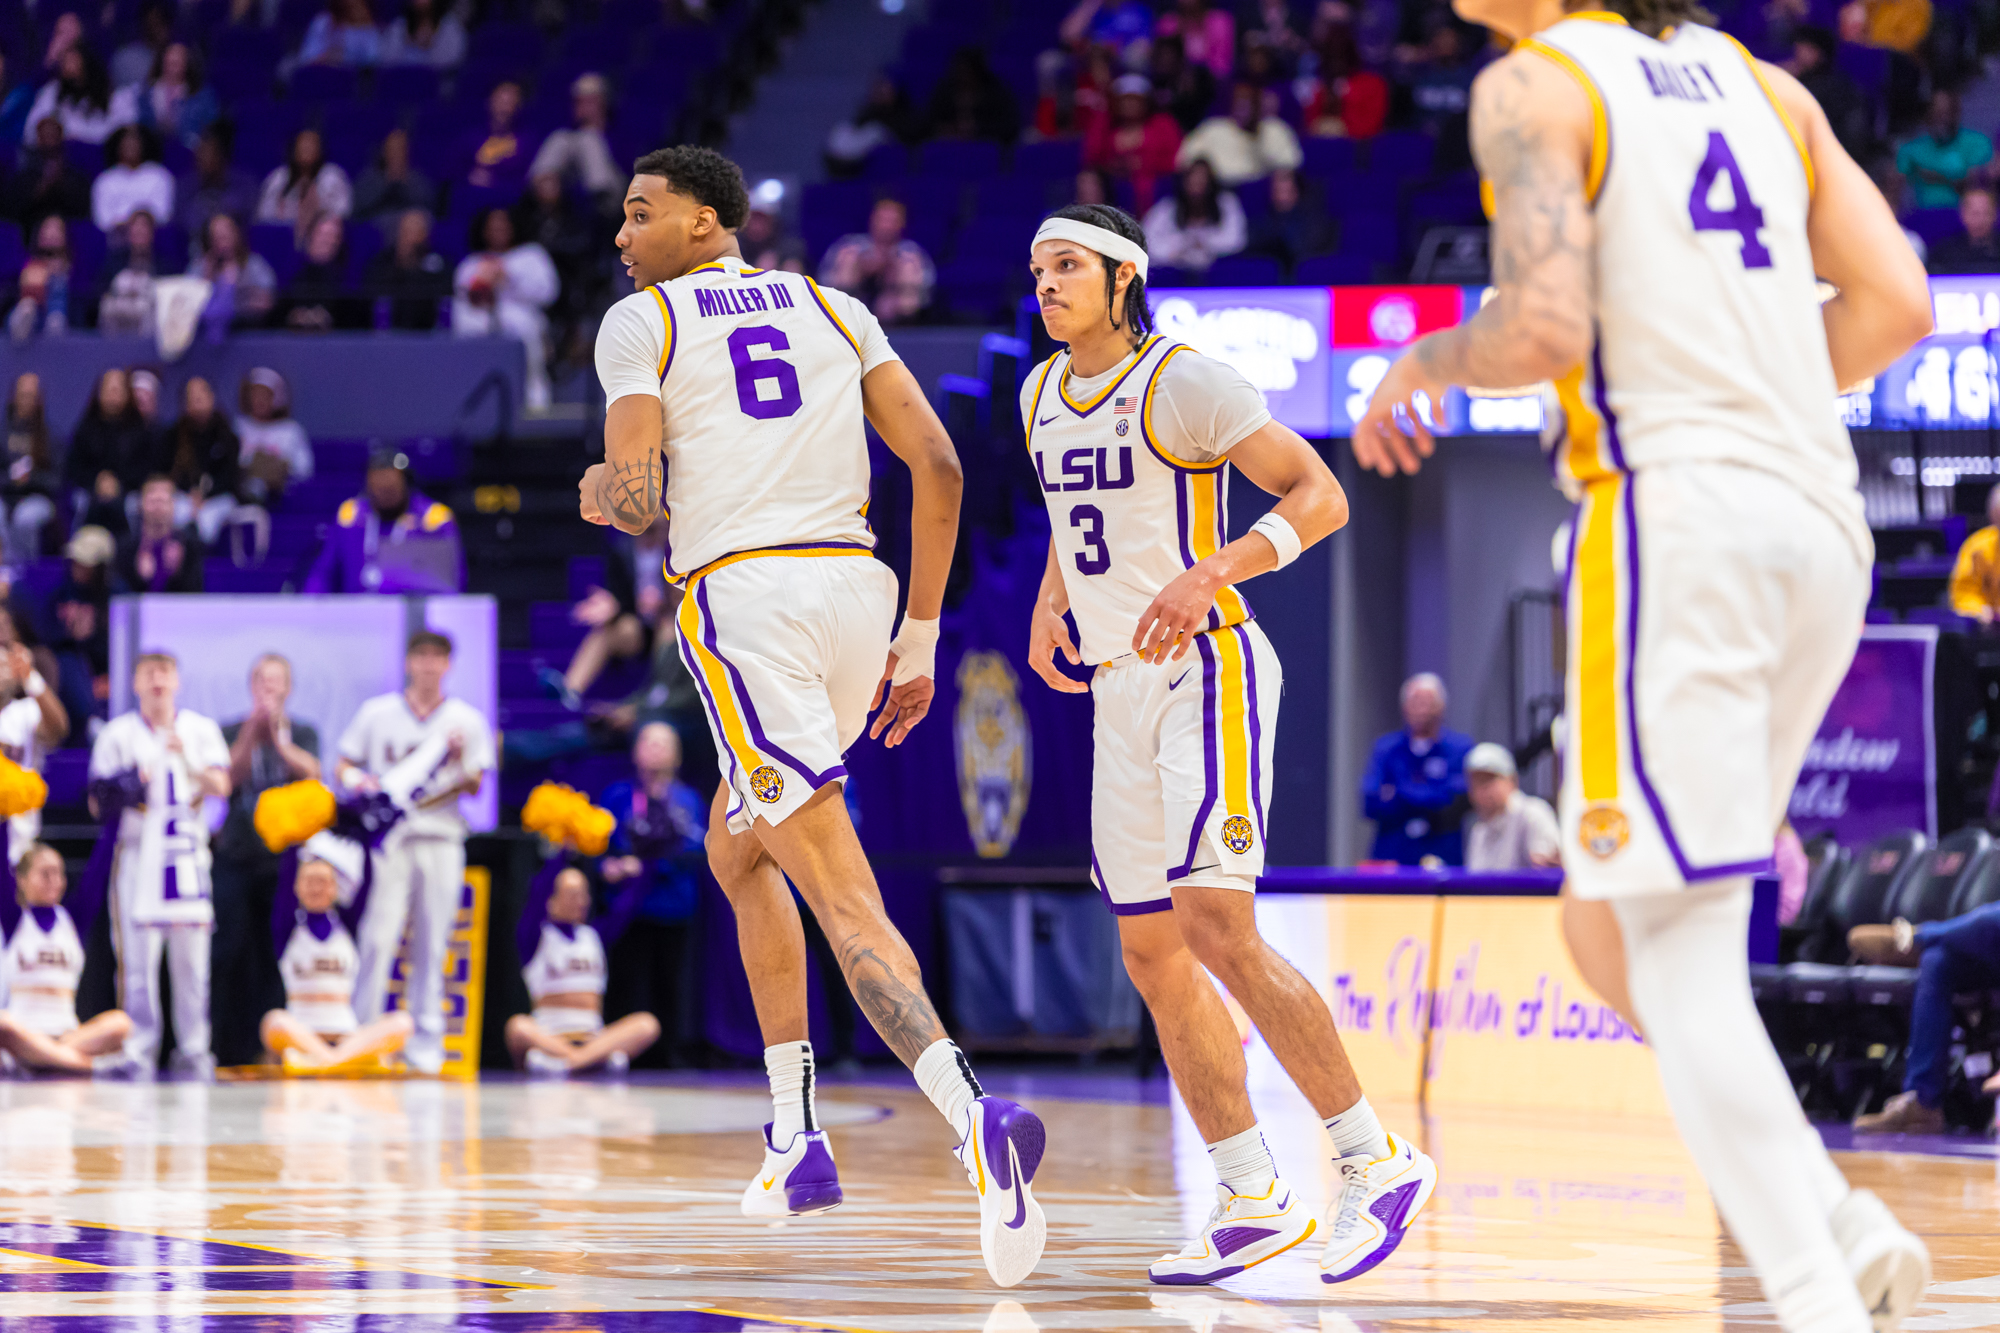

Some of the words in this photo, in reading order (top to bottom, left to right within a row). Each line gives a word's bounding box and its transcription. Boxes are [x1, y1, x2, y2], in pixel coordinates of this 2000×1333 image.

[1688, 131, 1773, 268] 4
[695, 287, 768, 317] MILLER
[766, 283, 795, 310] III
[727, 325, 803, 420] 6
[1035, 446, 1135, 492] LSU
[1070, 504, 1111, 576] 3
[1516, 973, 1547, 1038] of
